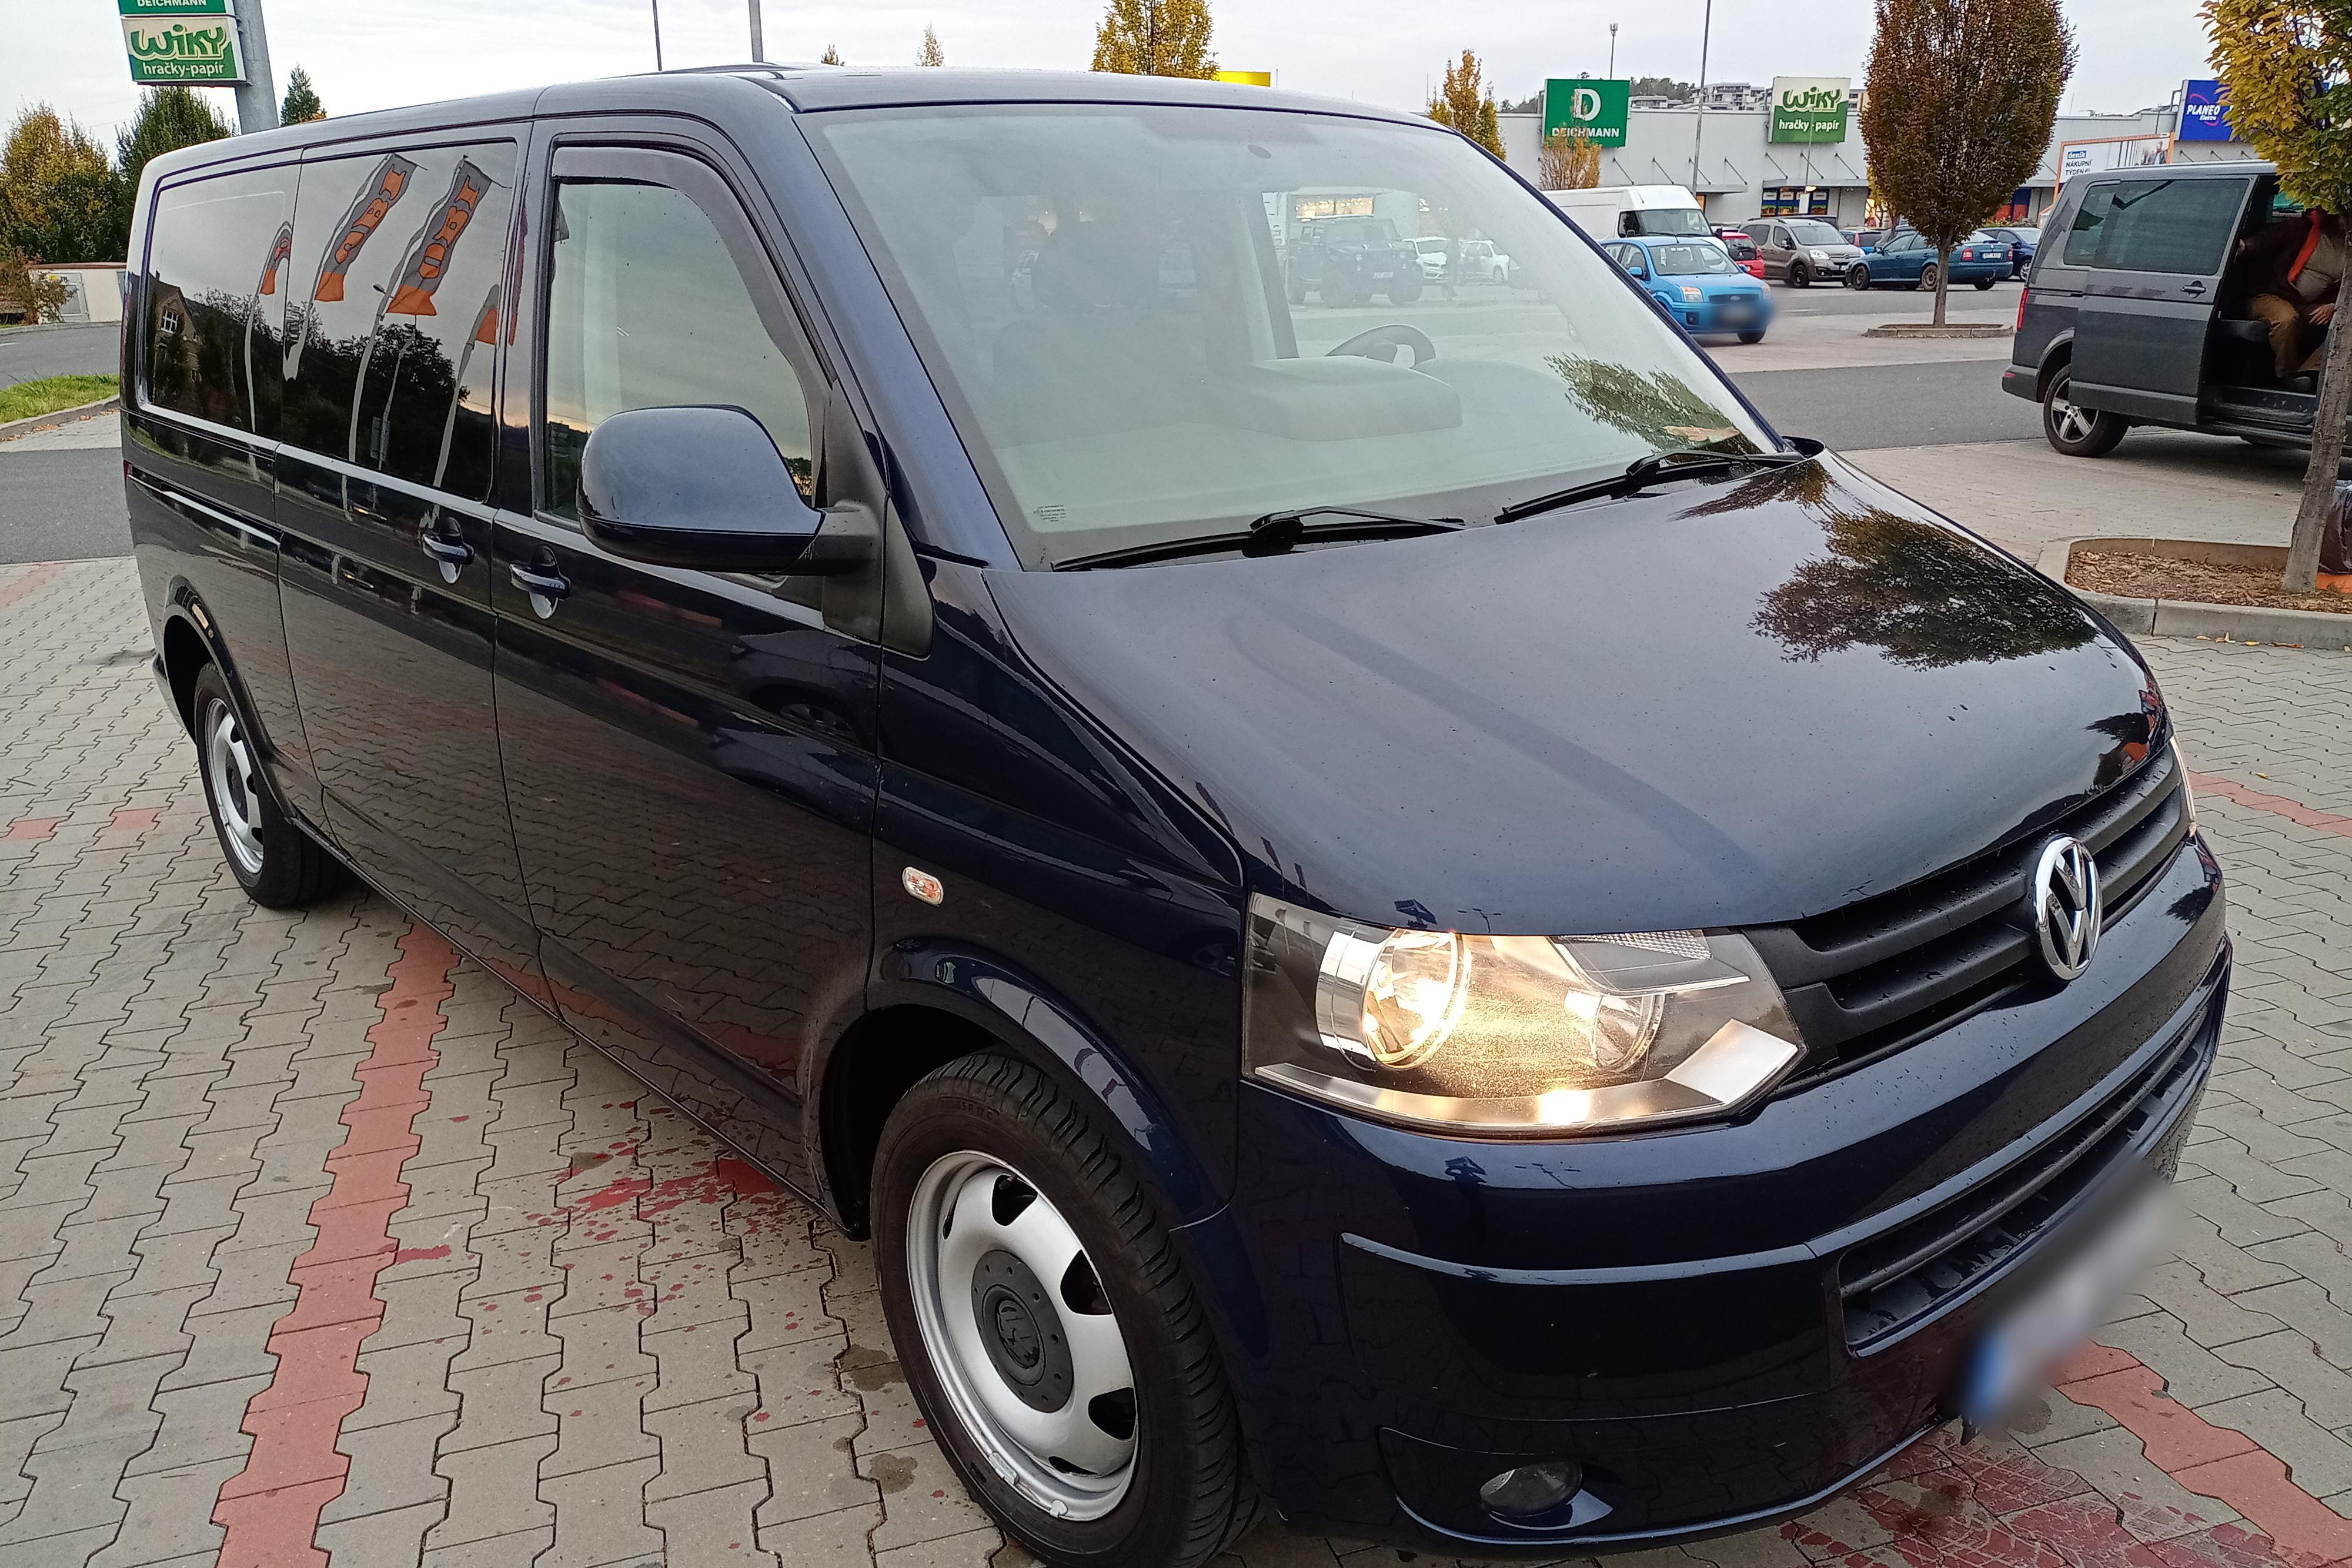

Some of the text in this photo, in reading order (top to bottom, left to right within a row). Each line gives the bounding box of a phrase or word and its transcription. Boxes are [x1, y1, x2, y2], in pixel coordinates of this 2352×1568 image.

[142, 61, 224, 77] hračky-papír
[1573, 88, 1601, 121] D
[2186, 105, 2221, 115] PLANEO
[1779, 119, 1809, 132] hračky
[1815, 119, 1840, 132] papír
[1552, 127, 1619, 137] DEICHMANN
[2066, 159, 2093, 168] NÁKUPNÍ
[2065, 168, 2084, 176] TÝDEN
